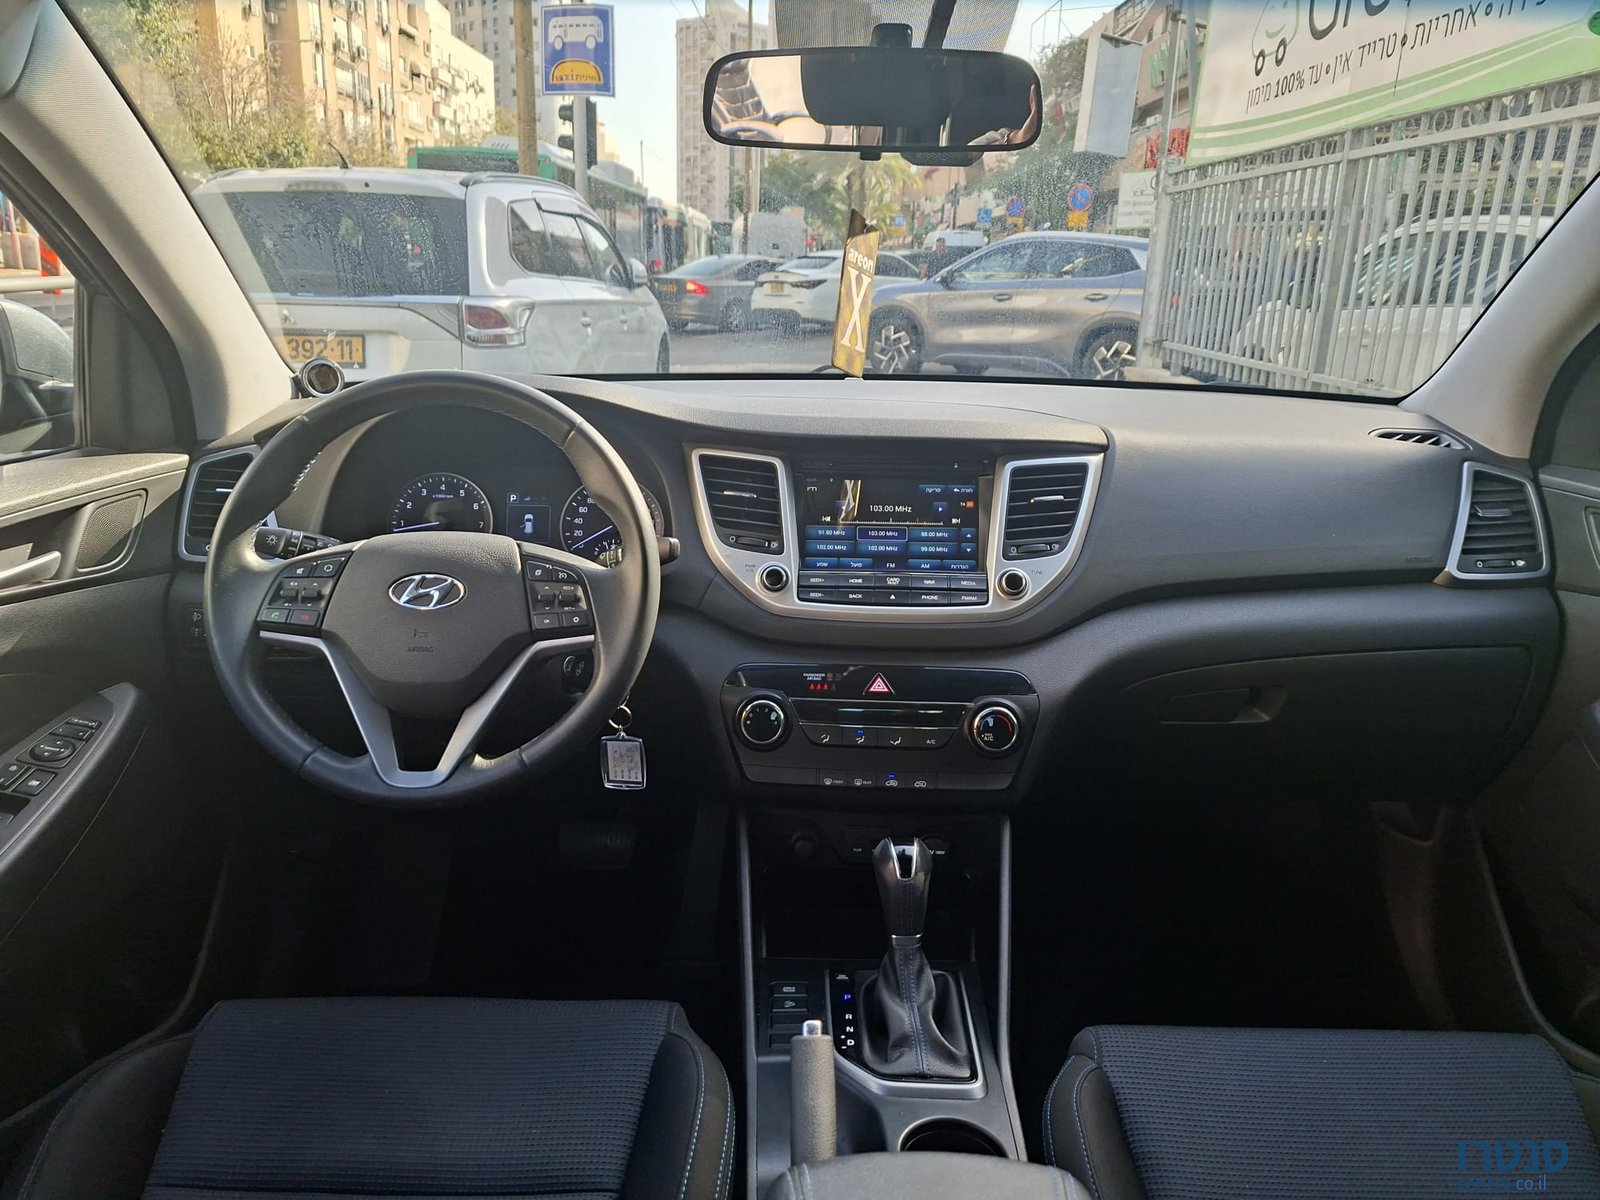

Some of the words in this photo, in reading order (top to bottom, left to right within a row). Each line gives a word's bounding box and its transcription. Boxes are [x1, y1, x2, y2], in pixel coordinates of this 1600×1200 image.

[1411, 1, 1481, 49] אחריות
[1358, 32, 1397, 67] טרייד
[1246, 82, 1271, 114] מימון
[1274, 68, 1305, 99] 100%
[848, 248, 874, 273] areon
[841, 266, 872, 352] X
[406, 501, 412, 509] 2
[510, 494, 517, 502] P
[895, 505, 912, 513] MHz
